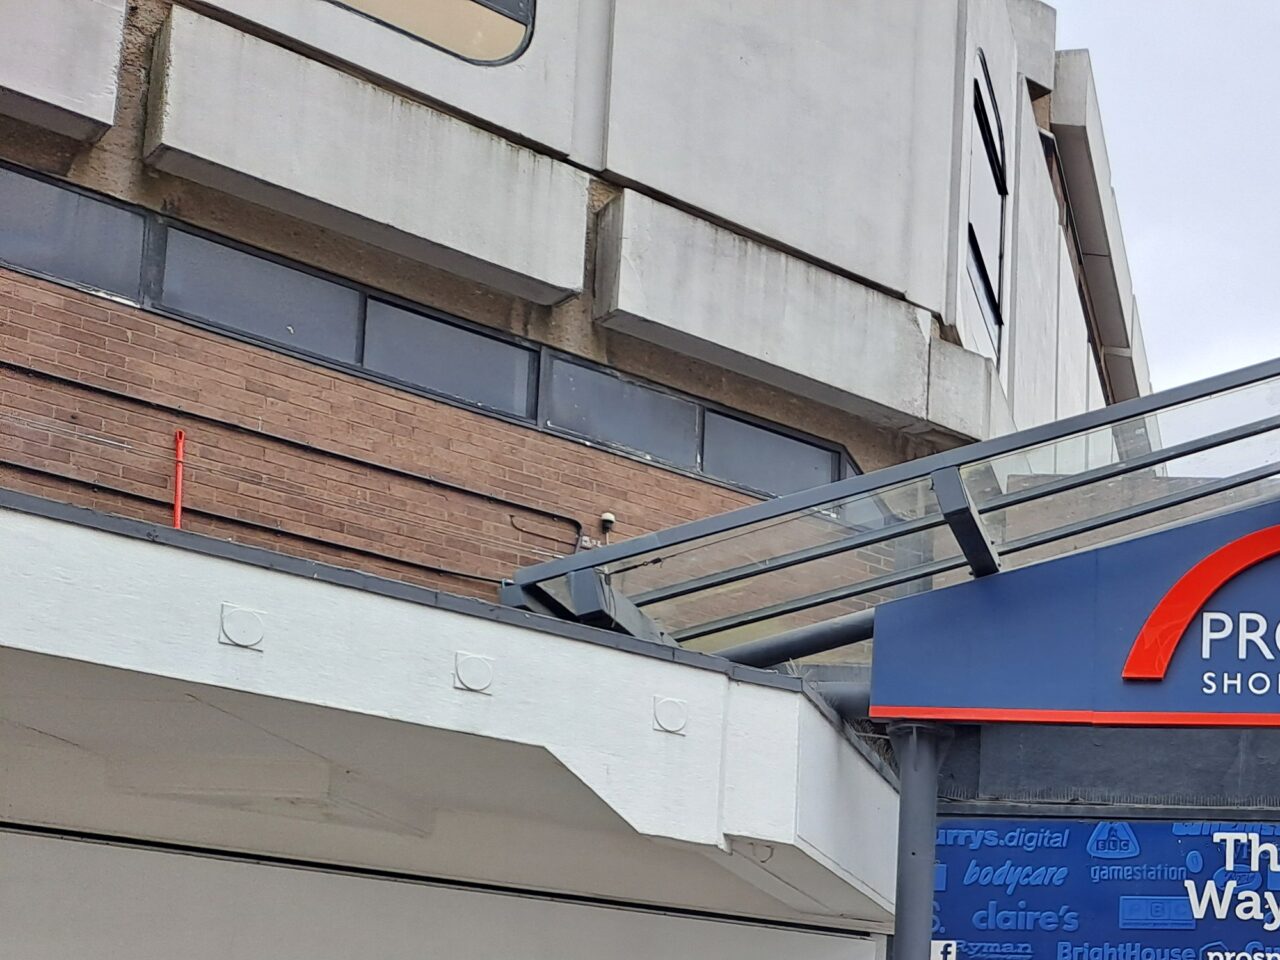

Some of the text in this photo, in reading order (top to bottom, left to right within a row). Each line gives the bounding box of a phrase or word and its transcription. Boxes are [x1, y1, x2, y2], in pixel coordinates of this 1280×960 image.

[936, 829, 1070, 851] urrys.digital
[963, 859, 1069, 895] bodycare
[1090, 864, 1187, 882] gamestation
[972, 900, 1080, 932] claire's
